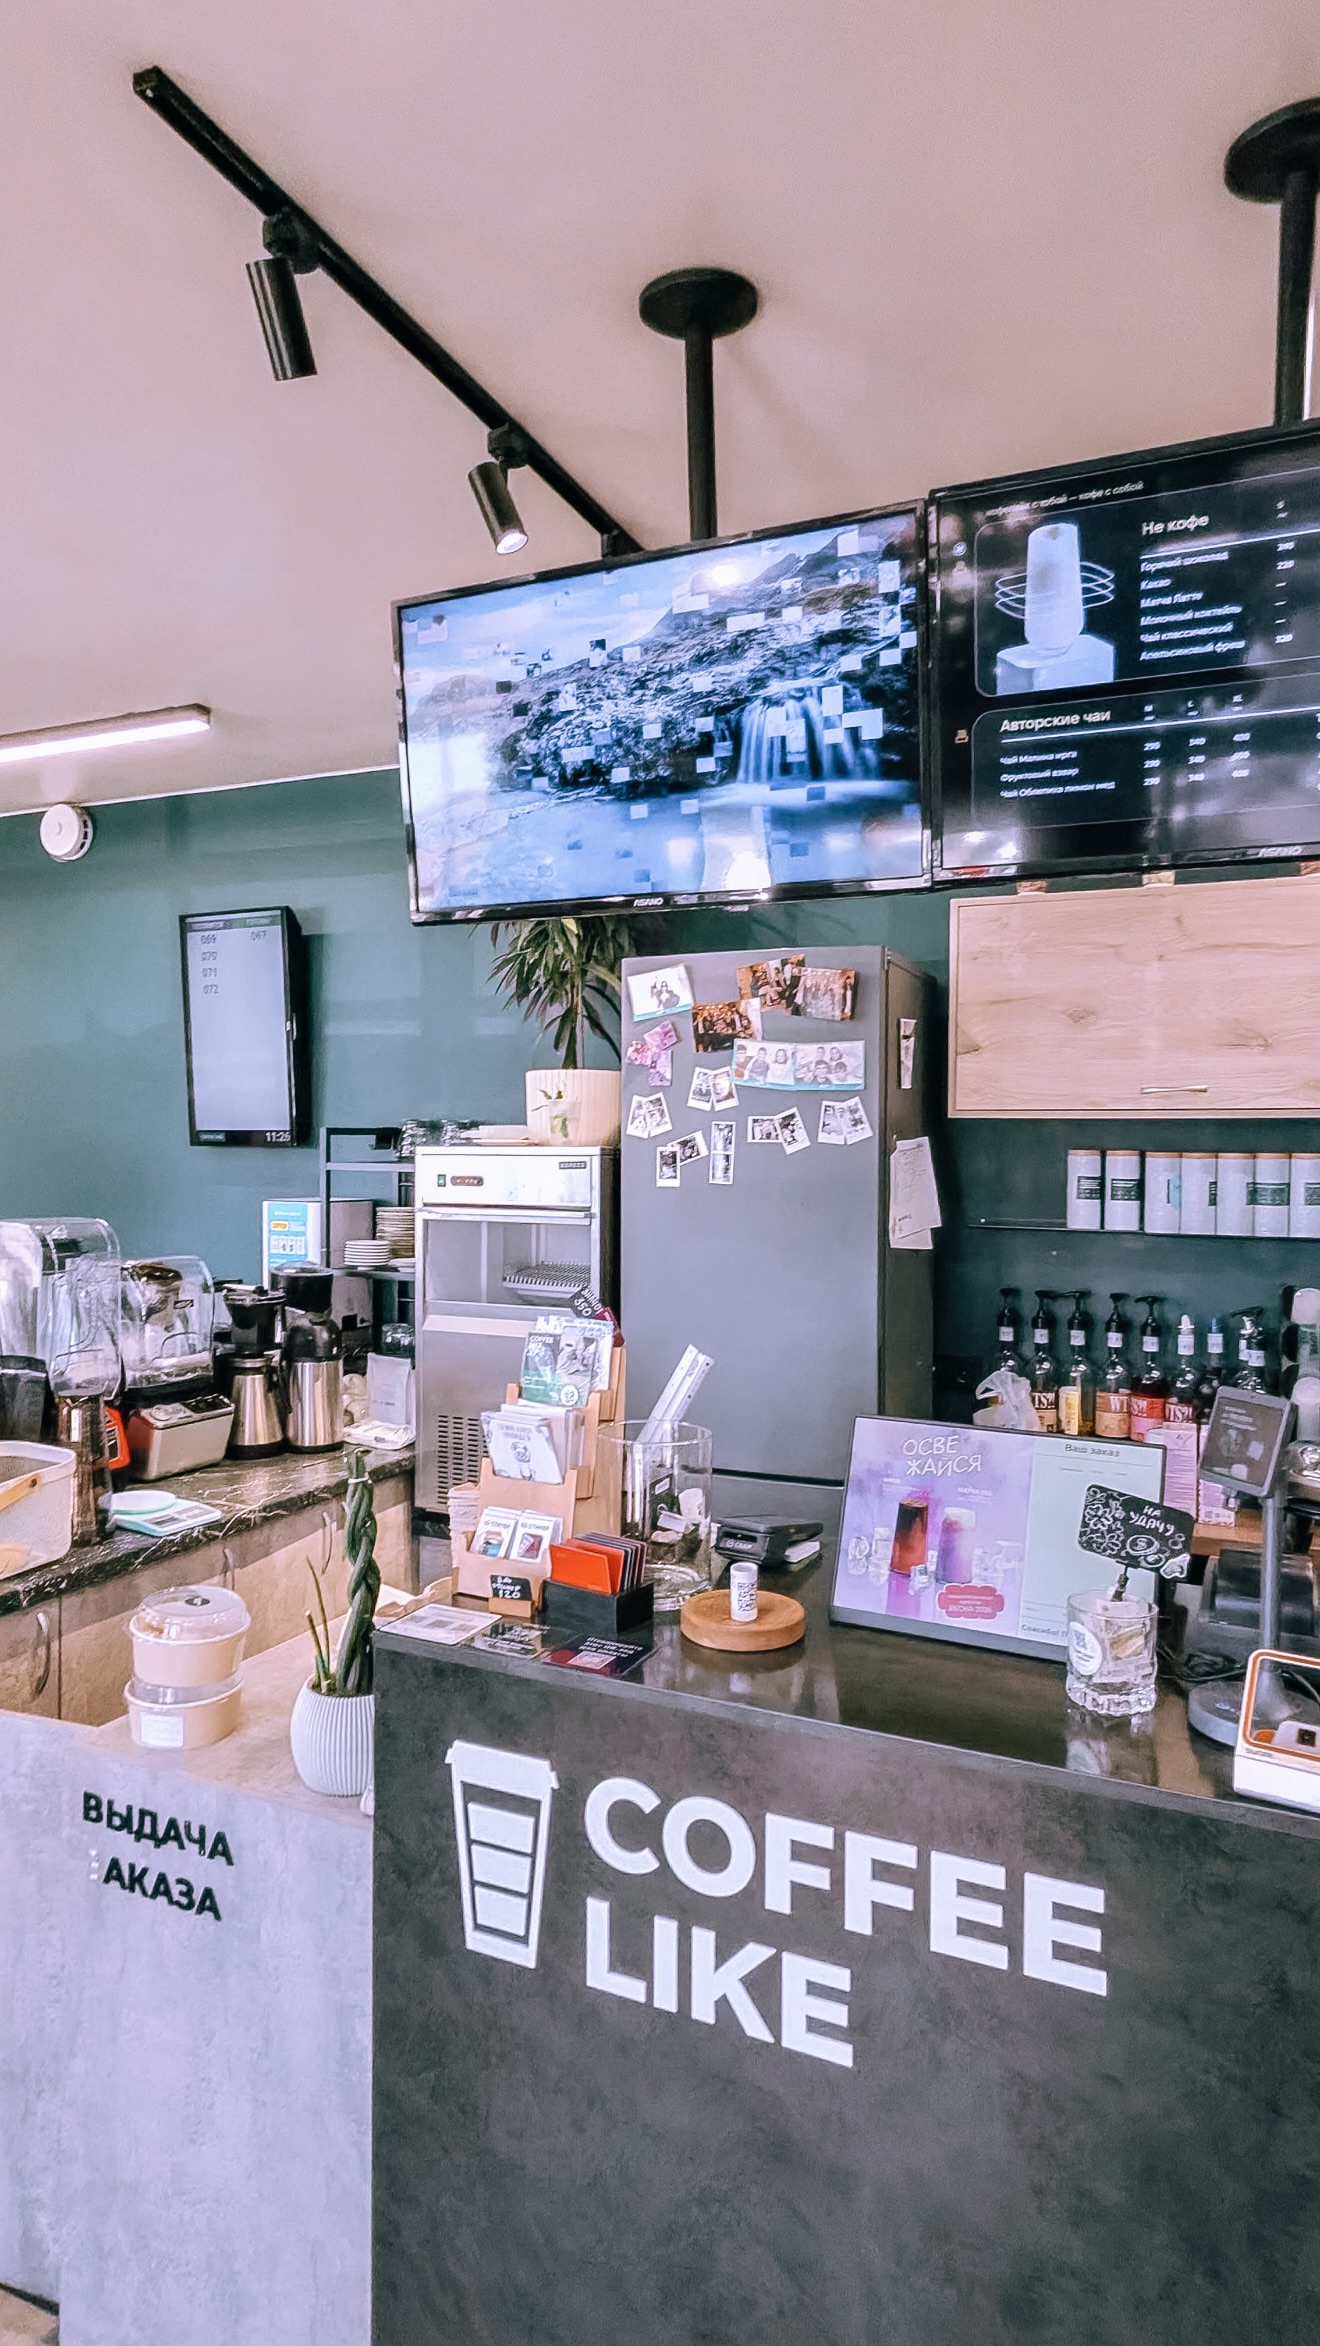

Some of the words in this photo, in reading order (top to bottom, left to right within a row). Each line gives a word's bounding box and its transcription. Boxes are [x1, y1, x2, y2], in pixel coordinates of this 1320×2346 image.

[1141, 521, 1165, 536] Не
[1166, 514, 1210, 532] кофе
[1139, 631, 1161, 643] Чай
[1000, 713, 1080, 732] Авторские
[1082, 710, 1112, 723] чаи
[201, 968, 217, 978] 071
[203, 984, 219, 995] 072
[1031, 1392, 1056, 1409] TS?!
[902, 1435, 959, 1456] ОСВЕ
[1064, 1443, 1088, 1454] Ваш
[1089, 1447, 1120, 1458] заказ
[906, 1454, 982, 1477] ЖАЙСЯ
[1143, 1505, 1163, 1517] НА
[1129, 1511, 1175, 1537] УДАЧУ
[83, 1791, 234, 1866] ВЫДАЧА
[585, 1777, 1107, 1997] COFFEE
[586, 1897, 853, 2068] LIKE
